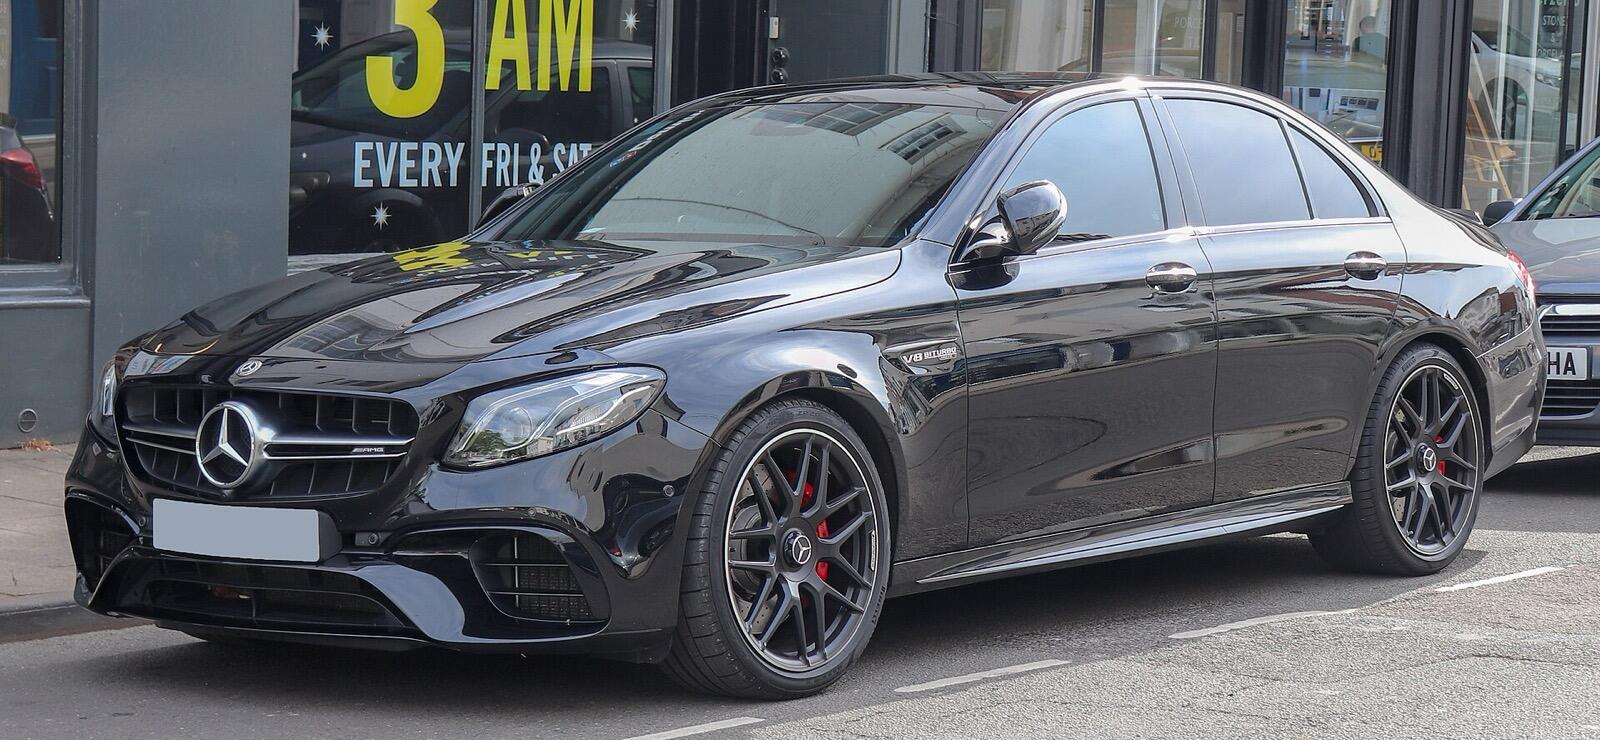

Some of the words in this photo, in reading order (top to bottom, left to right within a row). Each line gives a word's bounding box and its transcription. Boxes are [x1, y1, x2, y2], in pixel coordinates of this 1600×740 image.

[485, 0, 594, 92] AM
[353, 141, 466, 188] EVERY
[481, 142, 520, 187] FRI
[528, 142, 545, 186] &
[902, 353, 923, 364] V8
[1547, 351, 1577, 376] HA
